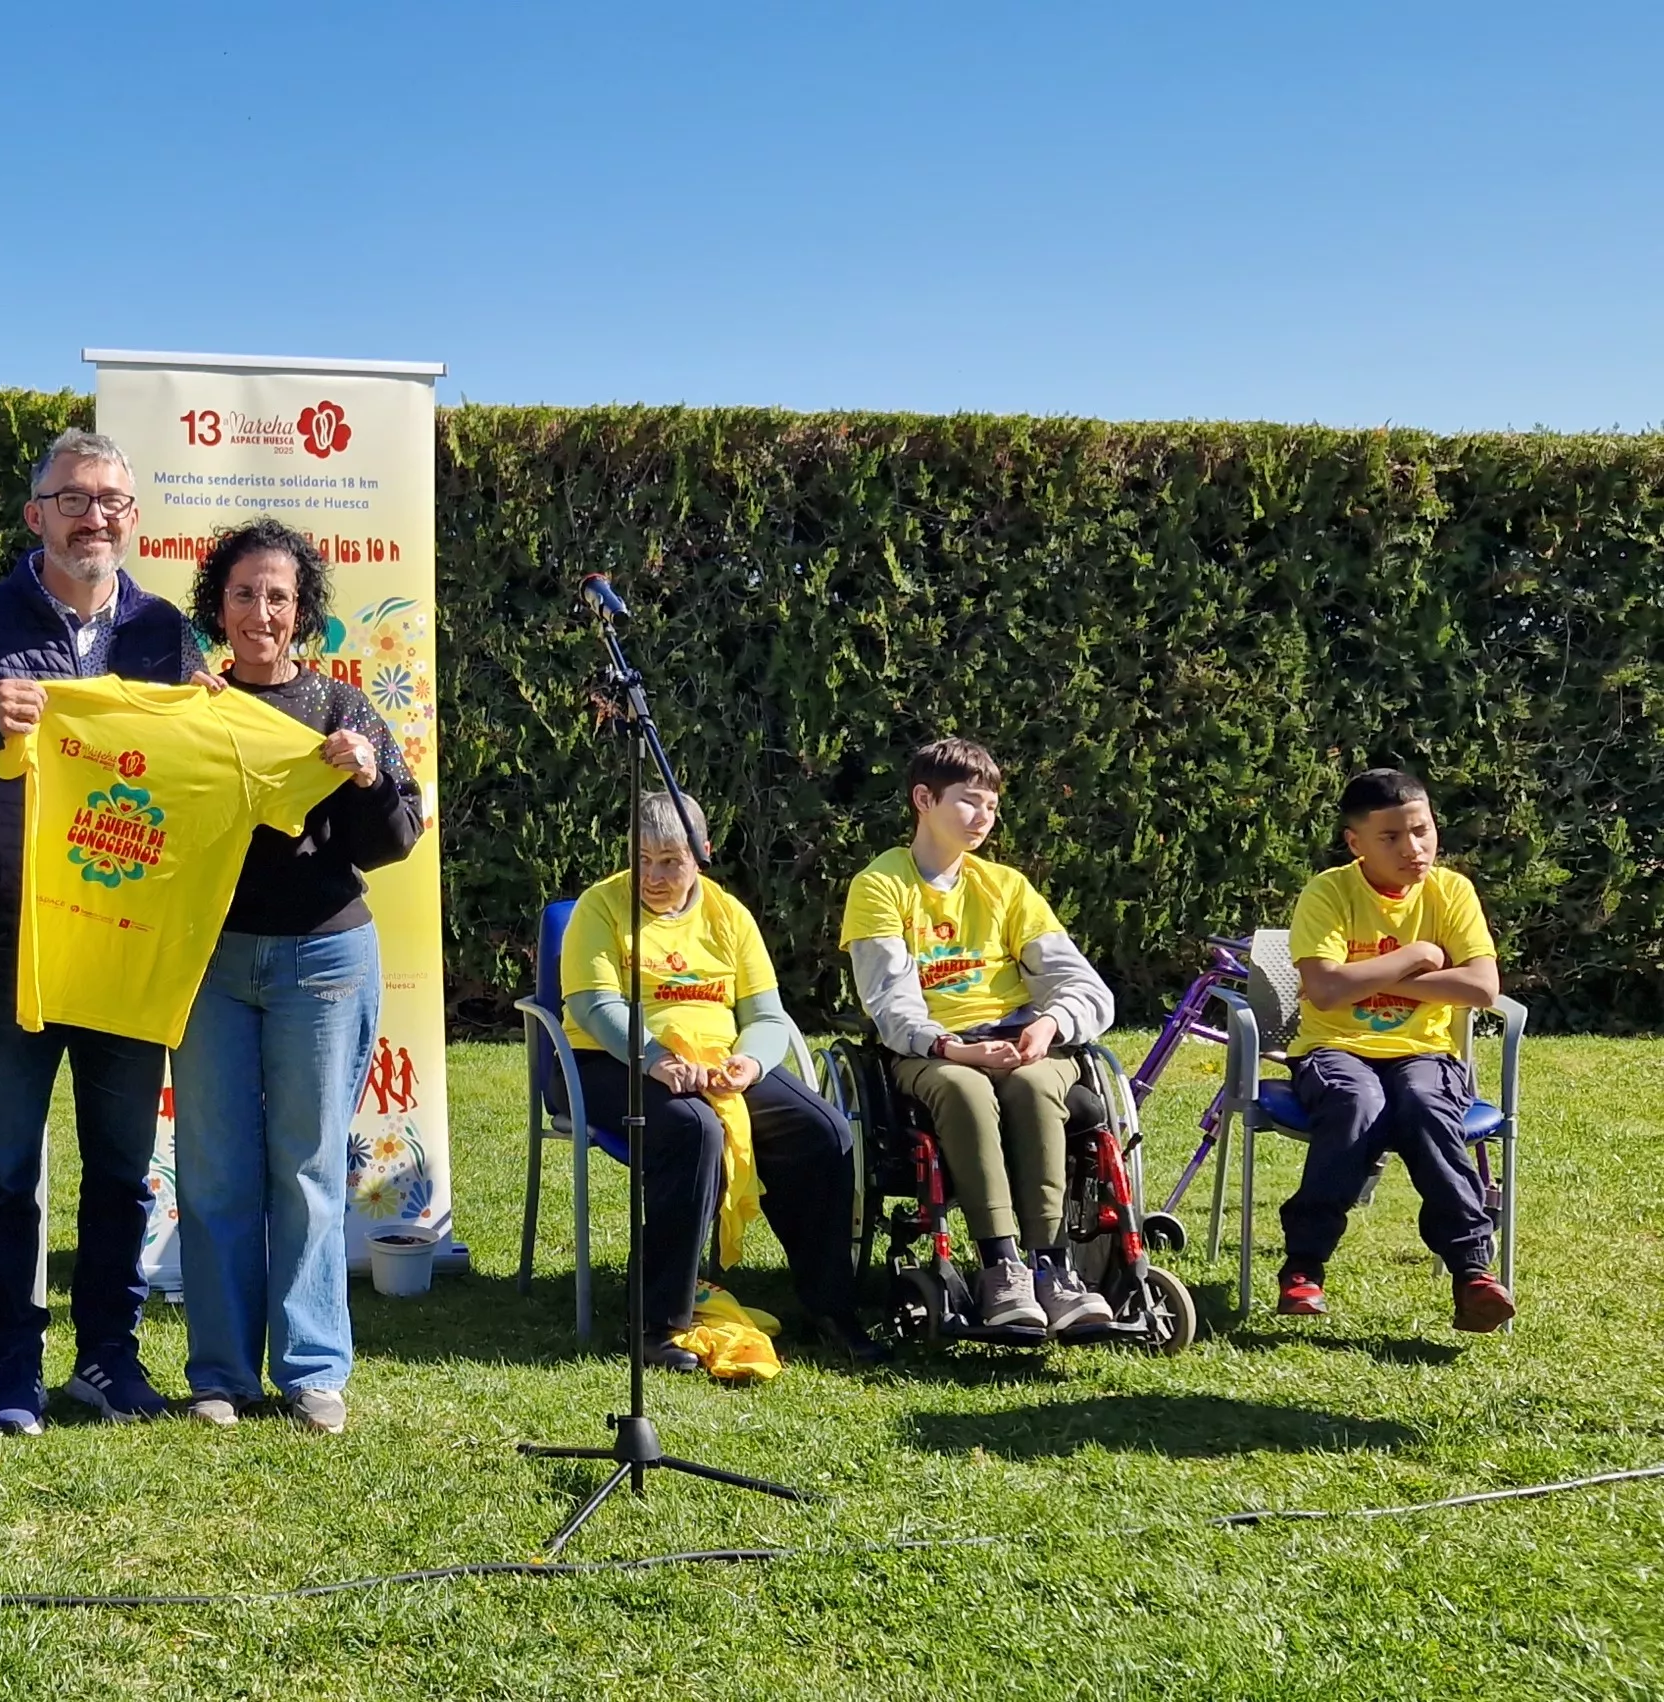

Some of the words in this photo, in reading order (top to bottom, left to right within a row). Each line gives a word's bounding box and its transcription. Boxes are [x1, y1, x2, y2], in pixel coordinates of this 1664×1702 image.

[229, 411, 295, 435] Marcha
[230, 435, 260, 445] ASPACE
[263, 436, 295, 446] HUESCA
[274, 447, 294, 455] 2025
[154, 472, 204, 485] Marcha
[208, 474, 275, 487] senderista
[280, 475, 337, 488] solidaria
[341, 477, 355, 489] 18
[359, 477, 378, 489] km
[164, 492, 211, 506] Palacio
[216, 494, 230, 507] de
[235, 495, 300, 510] Congresos
[305, 496, 320, 508] de
[324, 497, 369, 510] Huesca
[335, 534, 361, 563] las
[366, 537, 385, 562] 10
[390, 540, 400, 562] h
[60, 737, 81, 757] 13
[74, 807, 93, 827] LA
[95, 813, 147, 842] SUERTE
[147, 828, 167, 848] DE
[67, 825, 161, 865] CONOCERNOS
[386, 981, 416, 989] Huesca
